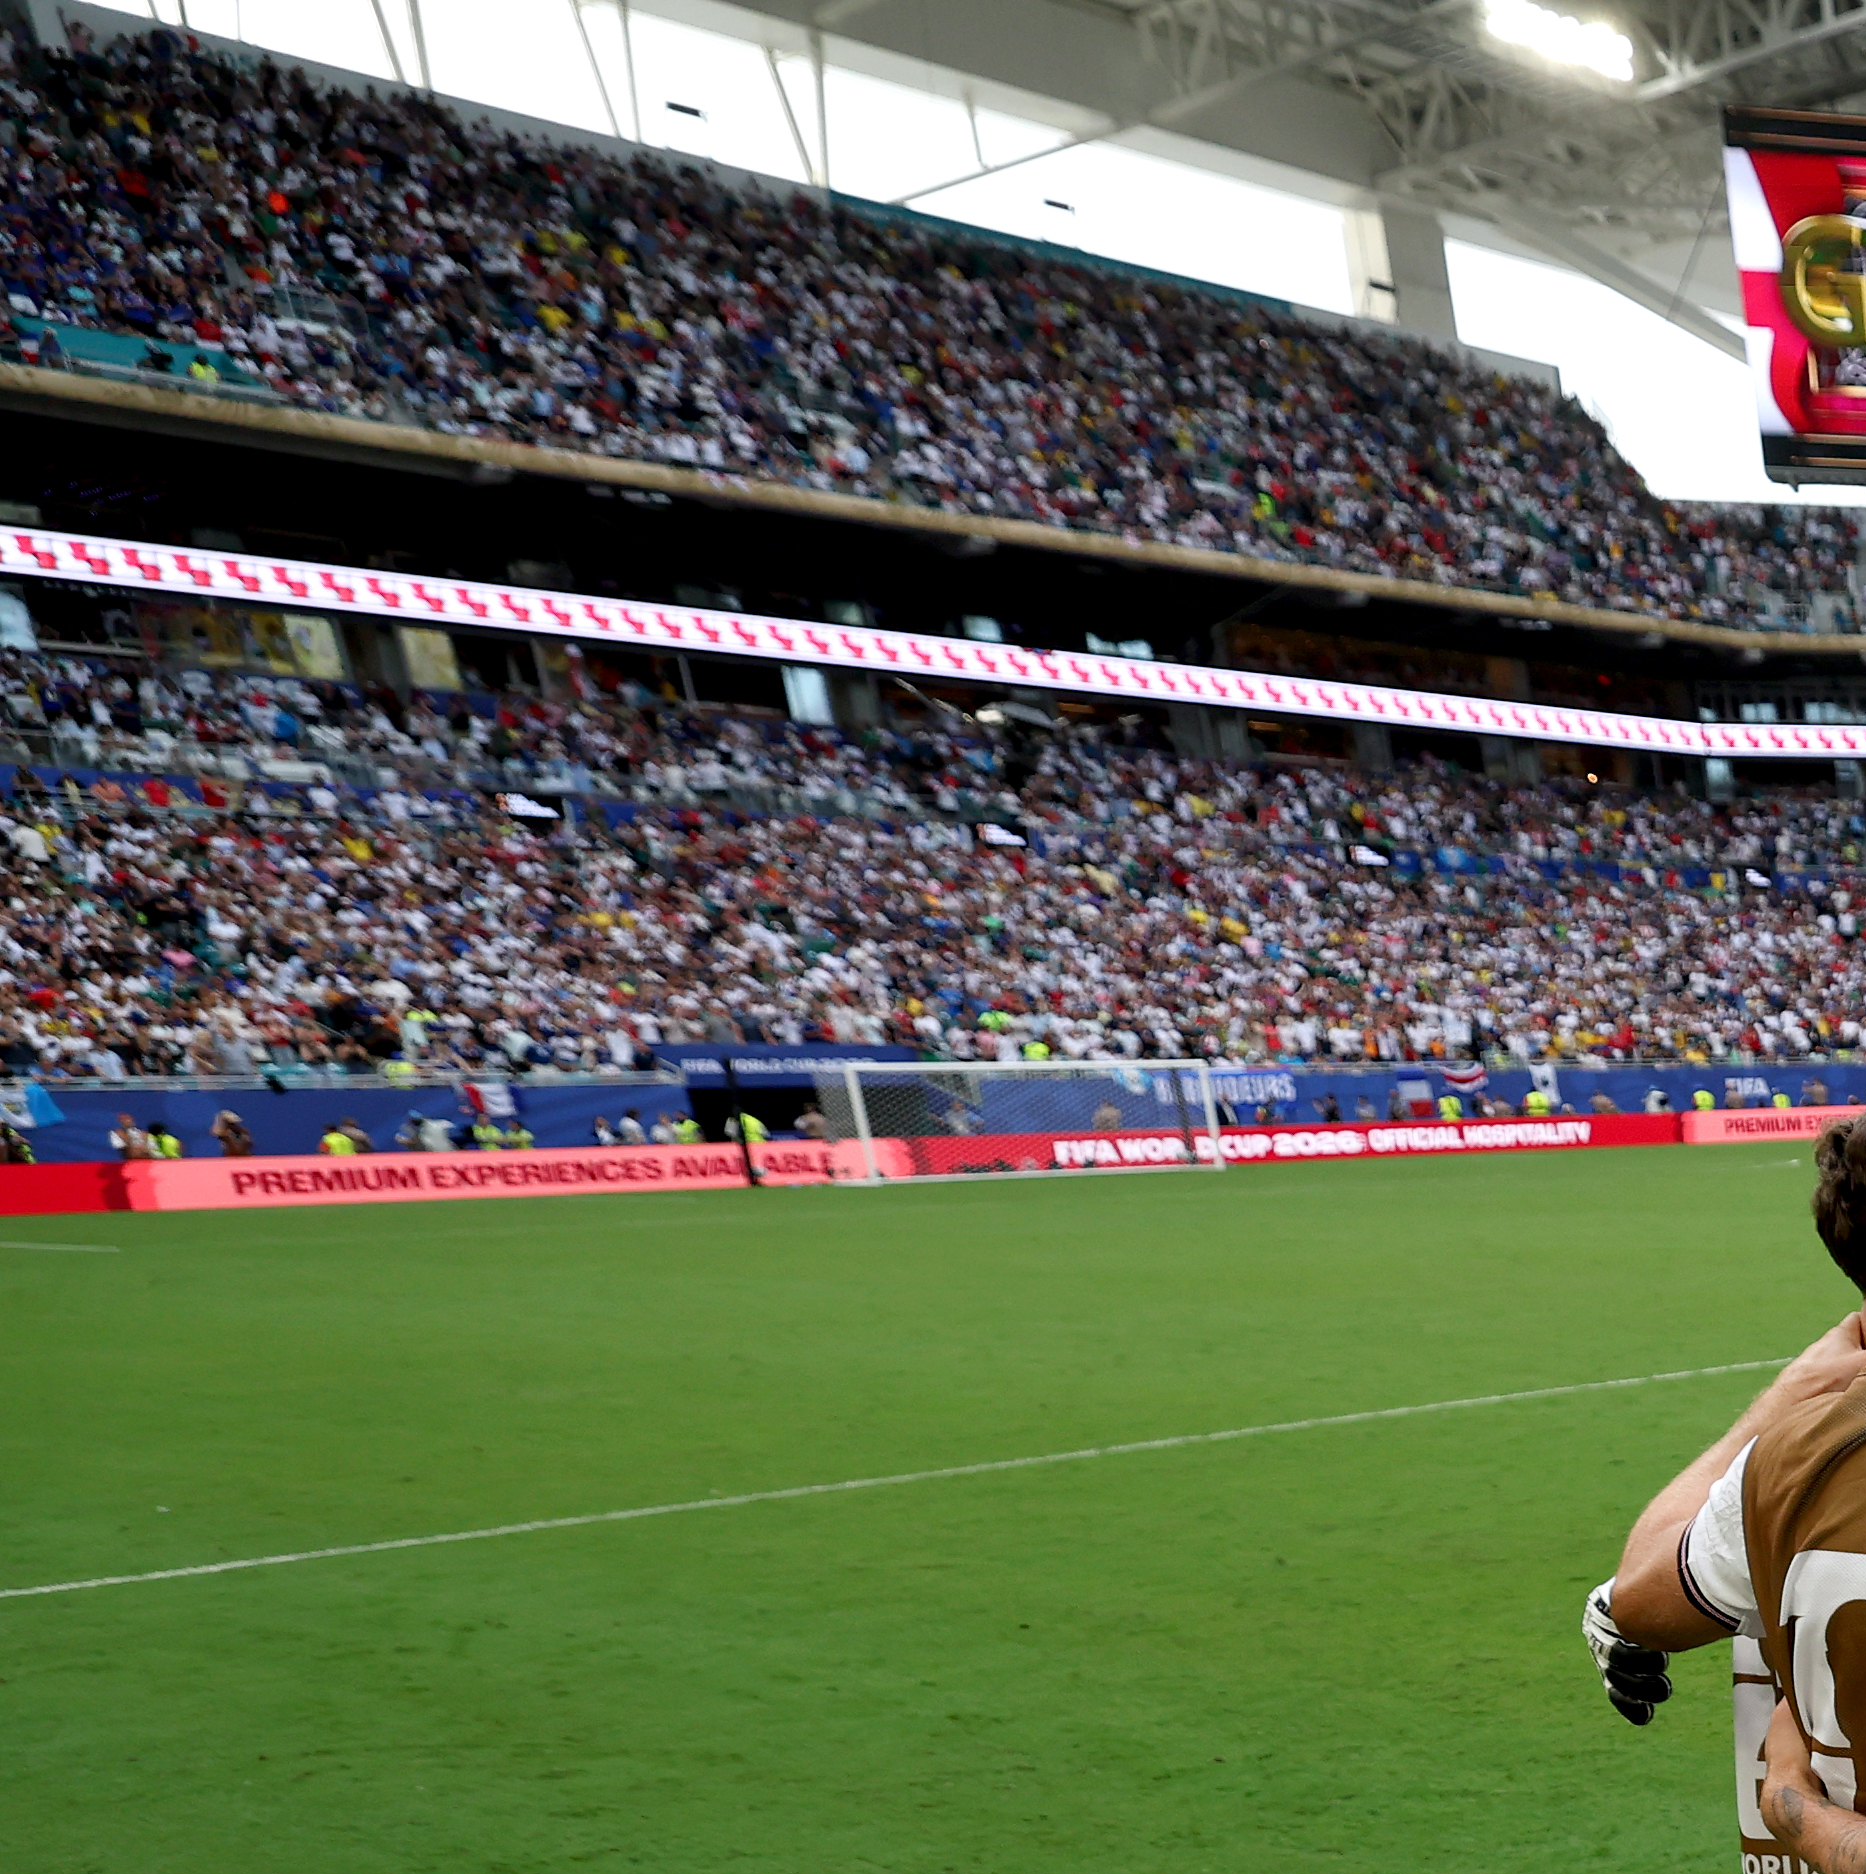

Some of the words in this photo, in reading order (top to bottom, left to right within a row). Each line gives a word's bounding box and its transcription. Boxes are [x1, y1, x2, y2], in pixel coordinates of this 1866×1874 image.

[1052, 1138, 1121, 1167] FIFA
[1116, 1134, 1217, 1164] WORD
[1218, 1133, 1273, 1158] CUP
[1367, 1125, 1465, 1153] OFFICIAL
[1463, 1121, 1592, 1149] HOSPITALITY
[1724, 1115, 1801, 1134] PREMIUM
[231, 1165, 423, 1195] PREMIUM
[427, 1156, 662, 1188] EXPERIENCES
[673, 1151, 832, 1180] AVAIABLE
